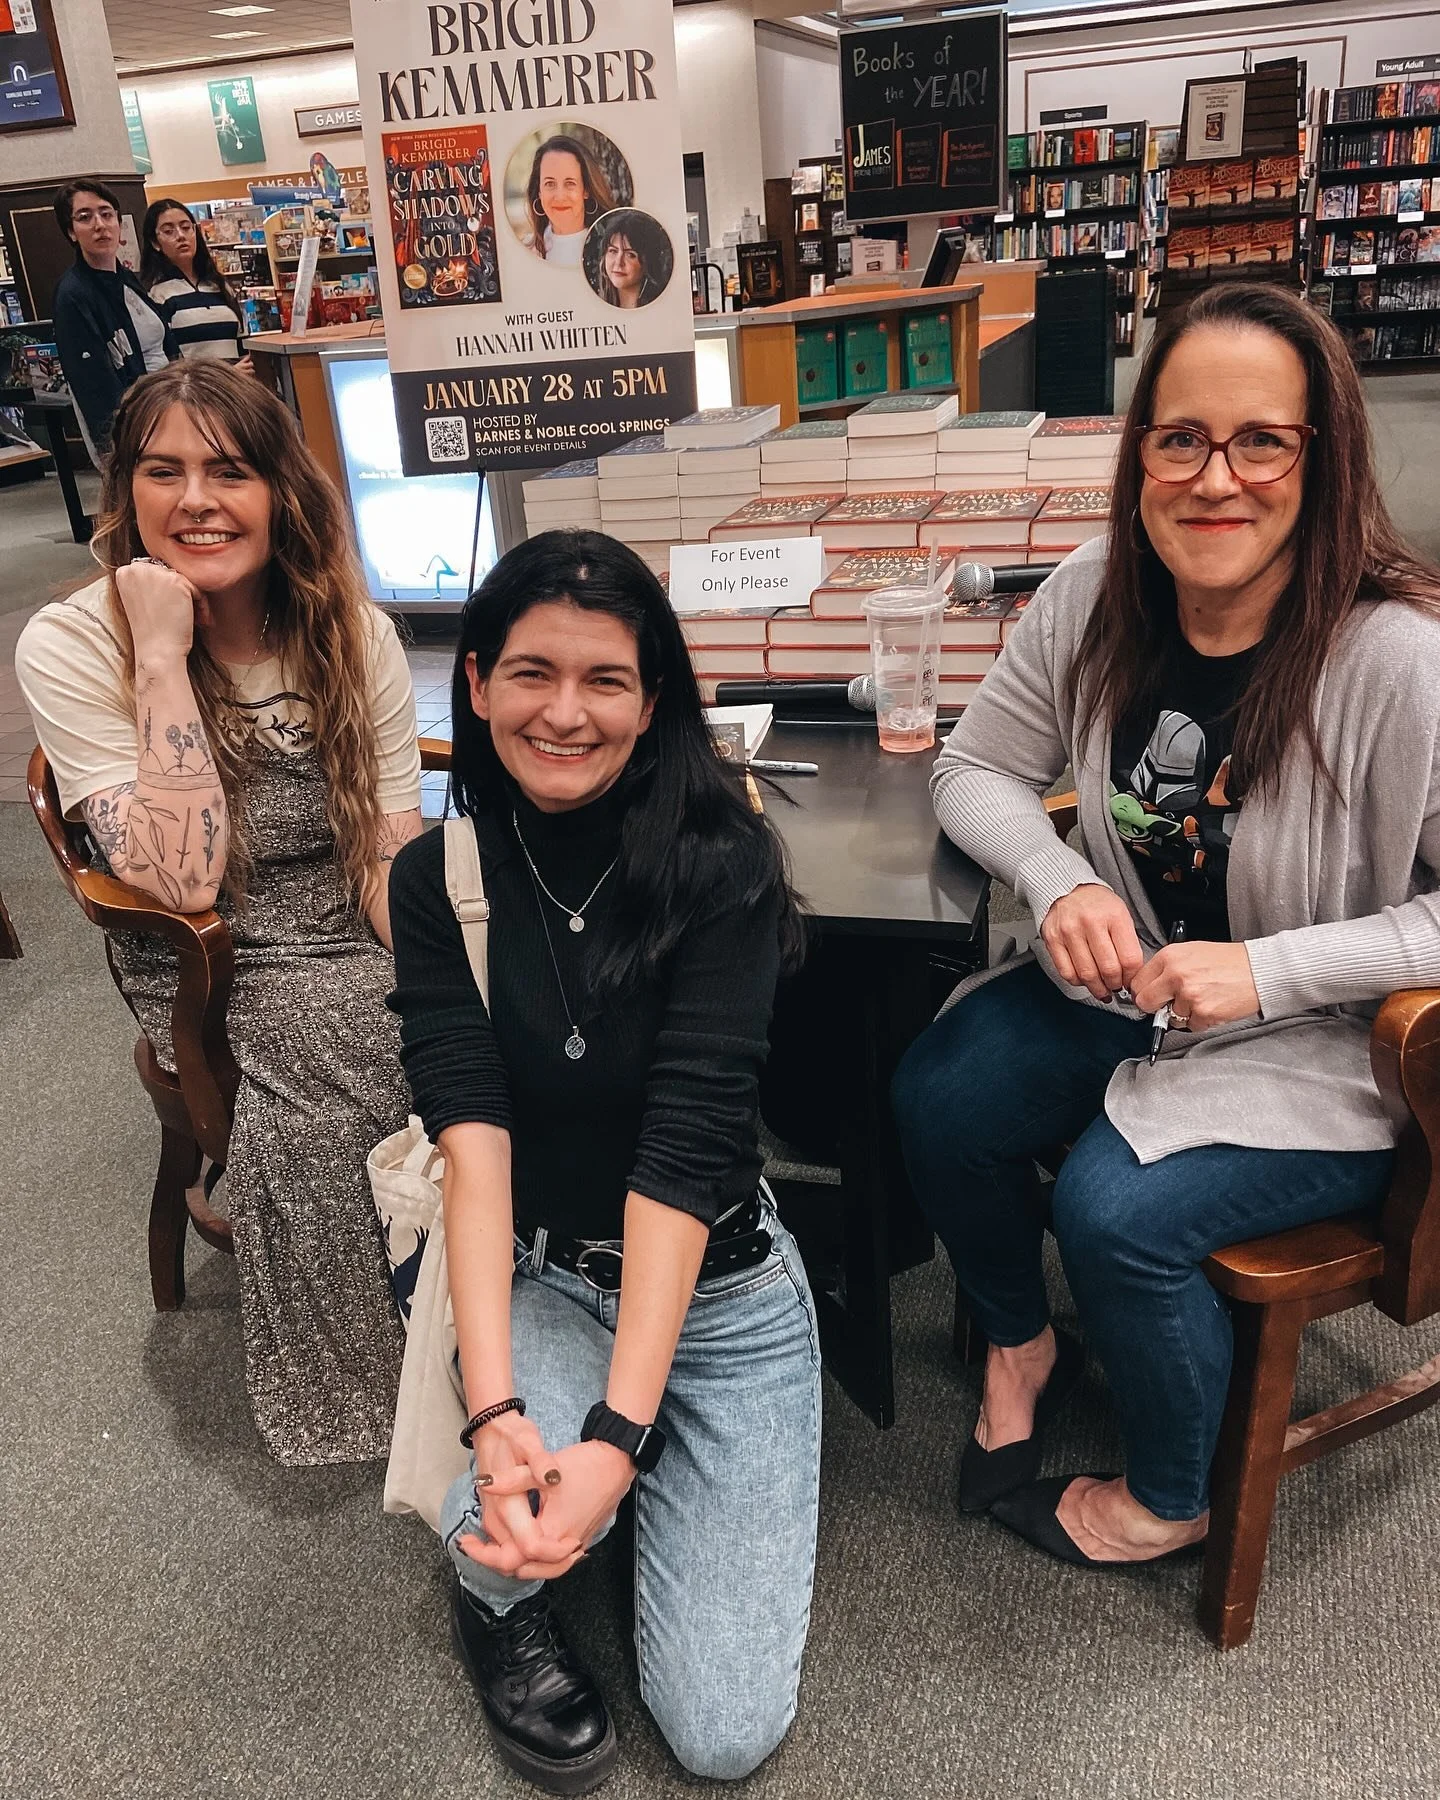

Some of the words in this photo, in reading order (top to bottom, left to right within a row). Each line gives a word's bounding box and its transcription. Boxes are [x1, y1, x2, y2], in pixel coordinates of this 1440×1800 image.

[427, 0, 596, 56] BRIGID
[853, 41, 915, 77] Books
[934, 35, 953, 65] of
[1381, 62, 1403, 72] Young
[1405, 60, 1424, 69] Adult
[377, 49, 657, 123] KEMMERER
[884, 86, 904, 103] the
[912, 66, 988, 108] YEAR!
[314, 109, 363, 126] GAMES
[401, 148, 471, 163] KEMMERER
[413, 138, 457, 151] BRIGID
[853, 124, 891, 168] JAMES
[393, 164, 484, 193] CARVING
[393, 192, 490, 221] SHADOWS
[430, 221, 455, 232] INTO
[413, 233, 477, 259] GOLD
[504, 313, 533, 326] WITH
[537, 310, 574, 324] GUEST
[456, 331, 534, 357] HANNAH
[539, 324, 628, 351] WHITTEN
[423, 375, 533, 411] JANUARY
[541, 373, 574, 402] 28
[583, 378, 604, 400] AT
[612, 366, 668, 397] 5PM
[473, 415, 522, 429] HOSTED
[524, 413, 538, 426] BY
[474, 428, 521, 443] BARNES
[524, 429, 533, 440] &
[536, 424, 577, 439] NOBLE
[579, 421, 617, 436] COOL
[619, 418, 670, 433] SPRINGS
[475, 446, 502, 457] SCAN
[503, 444, 522, 454] FOR
[524, 442, 552, 453] EVENT
[554, 440, 587, 451] DETAILS
[711, 549, 735, 563] For
[740, 546, 781, 561] Event
[702, 576, 736, 594] Only
[741, 575, 789, 590] Please
